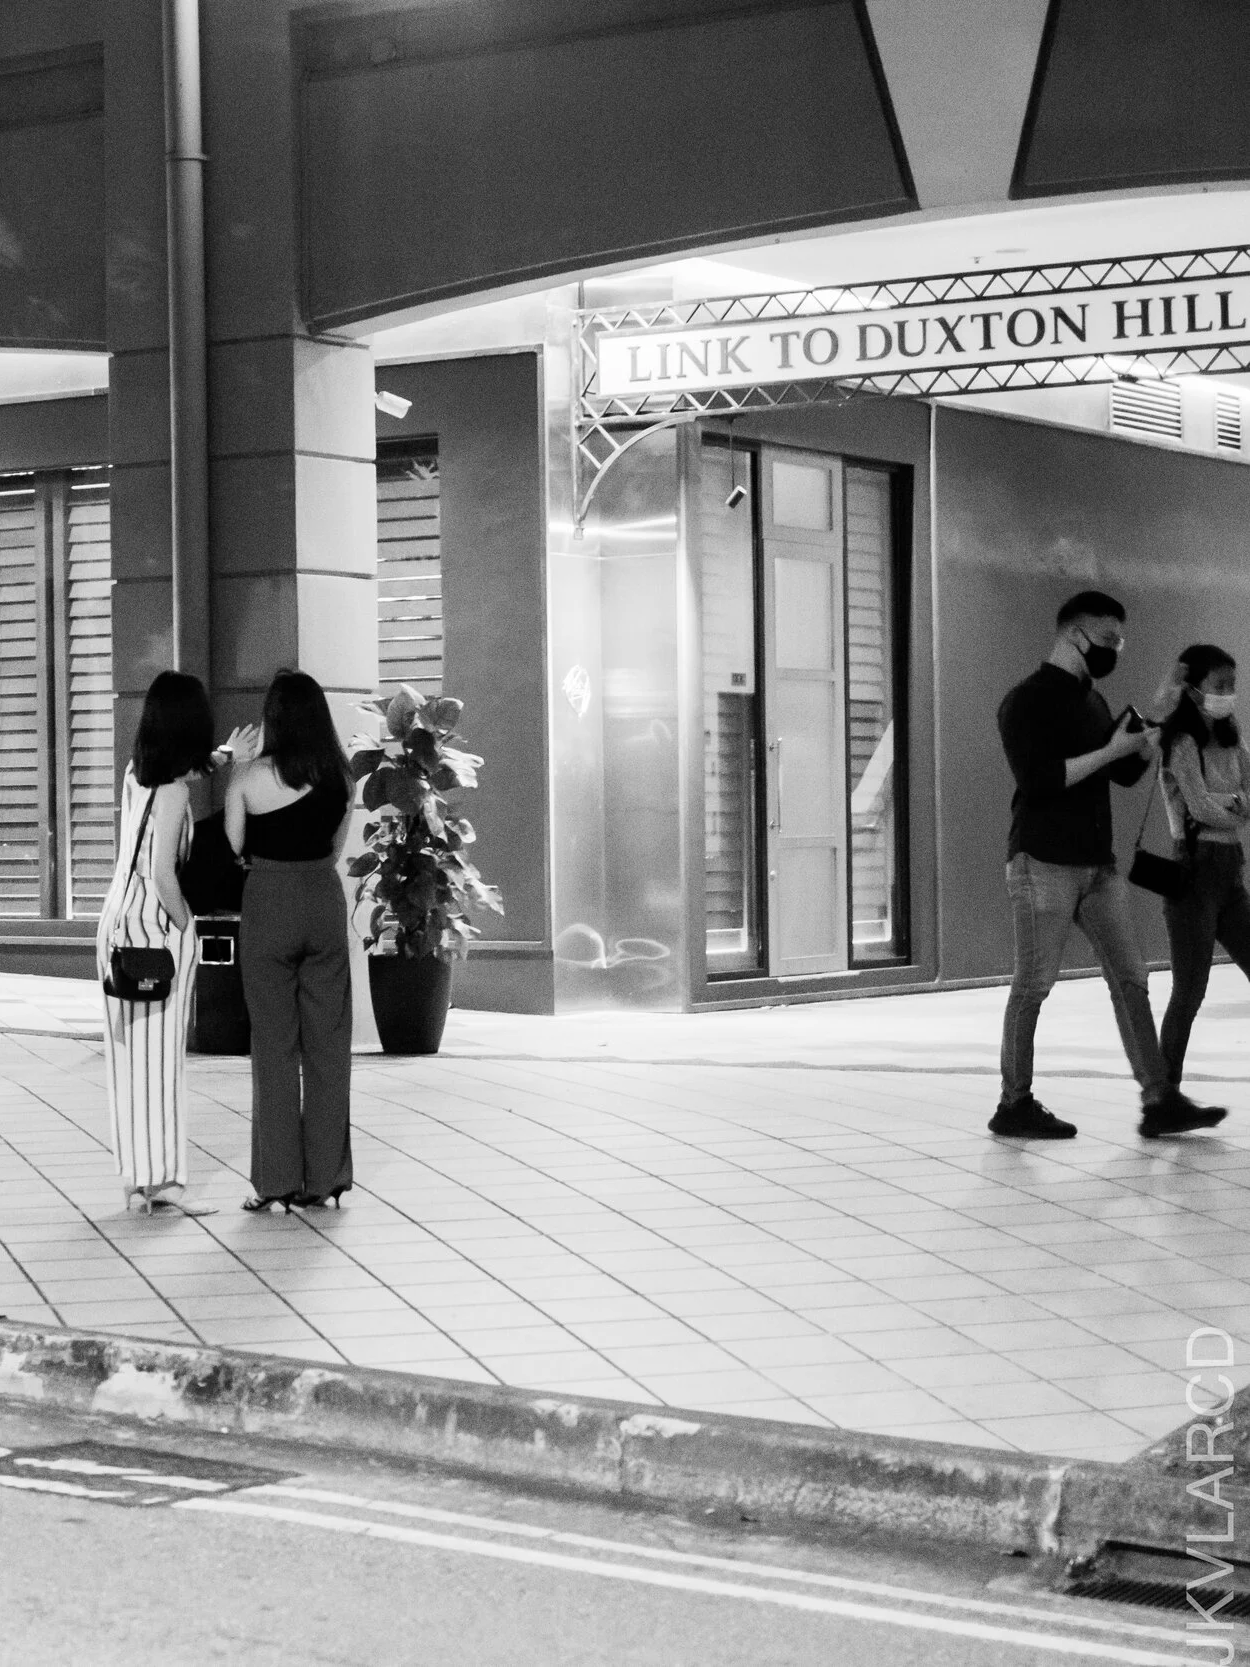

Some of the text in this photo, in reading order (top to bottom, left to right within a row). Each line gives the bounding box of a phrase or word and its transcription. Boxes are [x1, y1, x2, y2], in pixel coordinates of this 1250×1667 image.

[627, 291, 1247, 382] LINK TO DUXTON HILL
